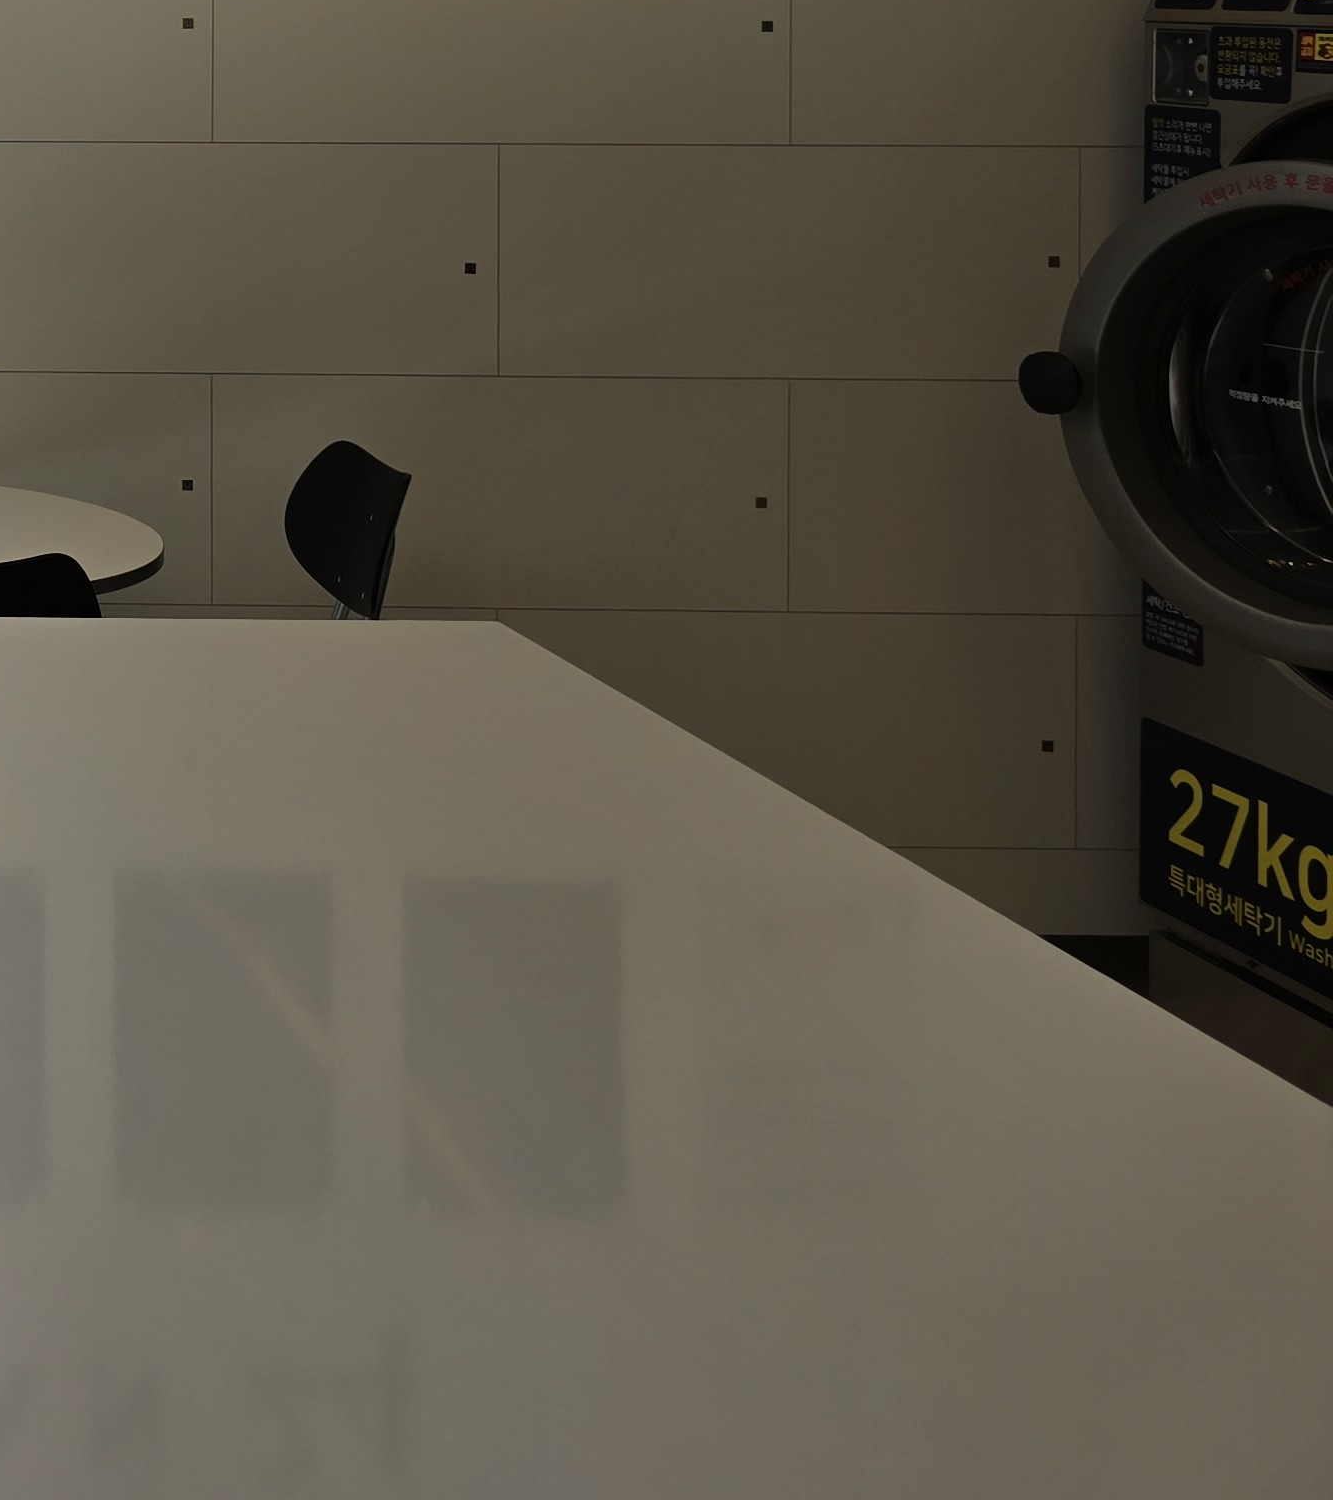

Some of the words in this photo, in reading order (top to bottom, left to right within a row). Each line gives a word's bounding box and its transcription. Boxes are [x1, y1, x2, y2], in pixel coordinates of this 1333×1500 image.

[1247, 174, 1277, 192] 사용
[1283, 173, 1299, 190] 후
[1168, 768, 1333, 941] 27kg
[1168, 863, 1283, 947] 특대형세탁기
